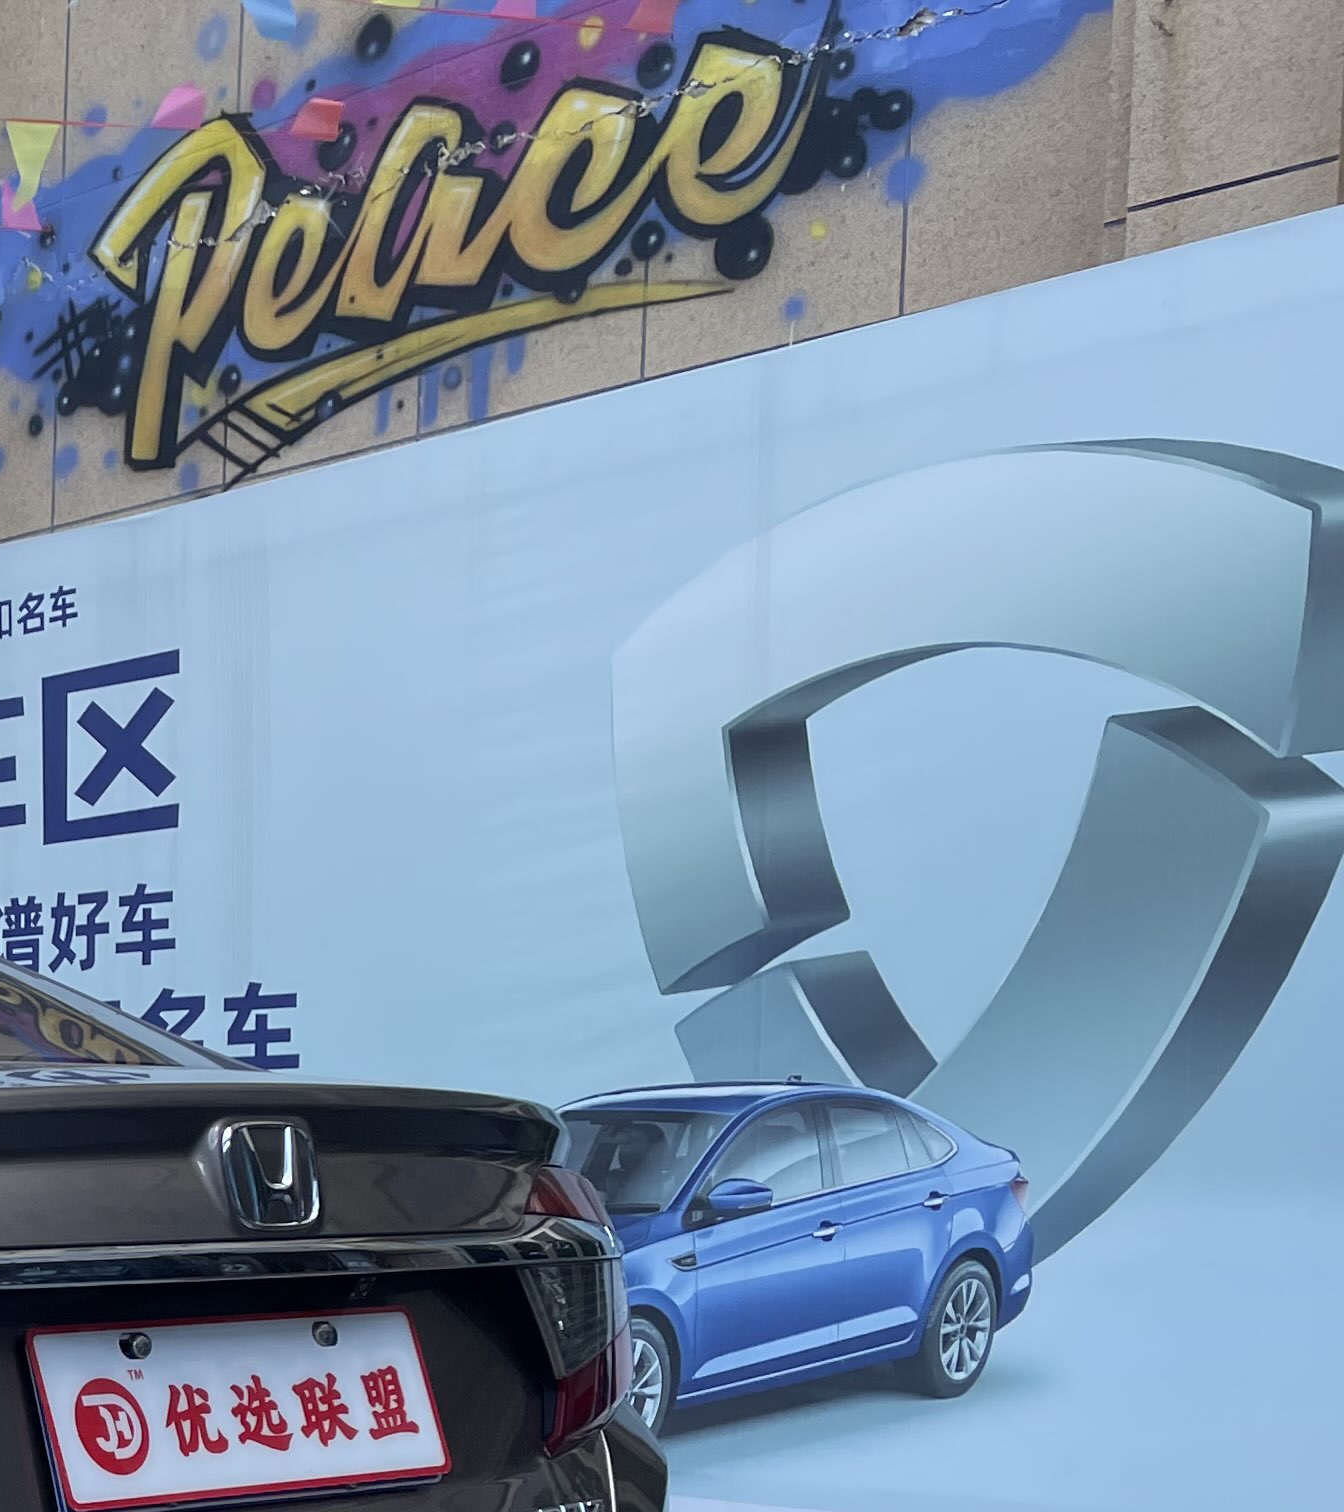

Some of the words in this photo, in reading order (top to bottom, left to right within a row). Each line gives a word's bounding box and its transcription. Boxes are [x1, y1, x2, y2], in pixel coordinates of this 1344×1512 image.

[88, 22, 824, 470] Peace
[166, 1365, 421, 1457] 优选联盟
